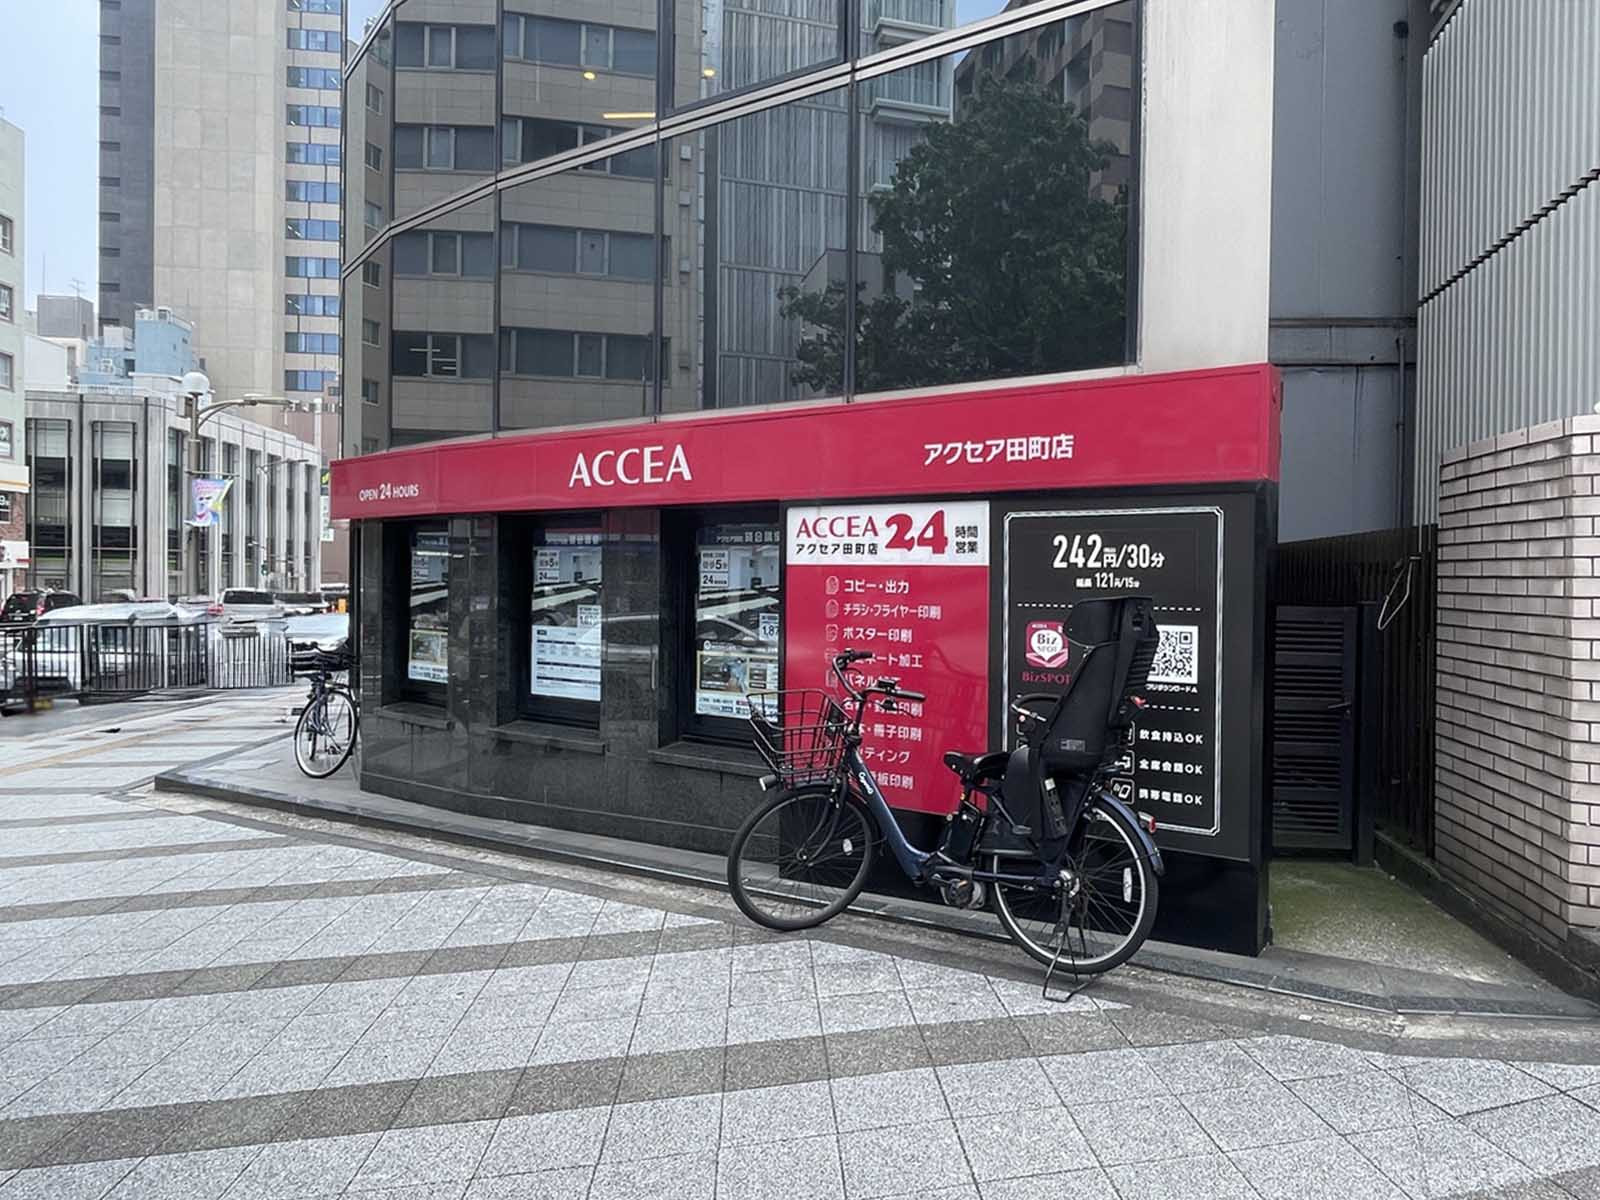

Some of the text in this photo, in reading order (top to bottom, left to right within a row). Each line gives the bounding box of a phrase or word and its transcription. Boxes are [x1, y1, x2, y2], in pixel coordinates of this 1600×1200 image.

[924, 434, 1075, 466] アクセア田町店
[568, 444, 693, 488] ACCEA
[359, 483, 420, 502] OPEN 24 HOURS
[796, 509, 949, 555] ACCEA 24
[955, 525, 978, 539] 時間
[796, 543, 879, 556] アクセア田町店
[955, 541, 978, 554] 営業
[843, 579, 910, 595] コピー・出力
[843, 604, 942, 620] チラシ・フライヤー印刷
[843, 627, 913, 643] ポスター印刷
[844, 652, 924, 668] ネート加工
[848, 722, 923, 742] ・冊子印刷
[860, 746, 911, 764] ティング
